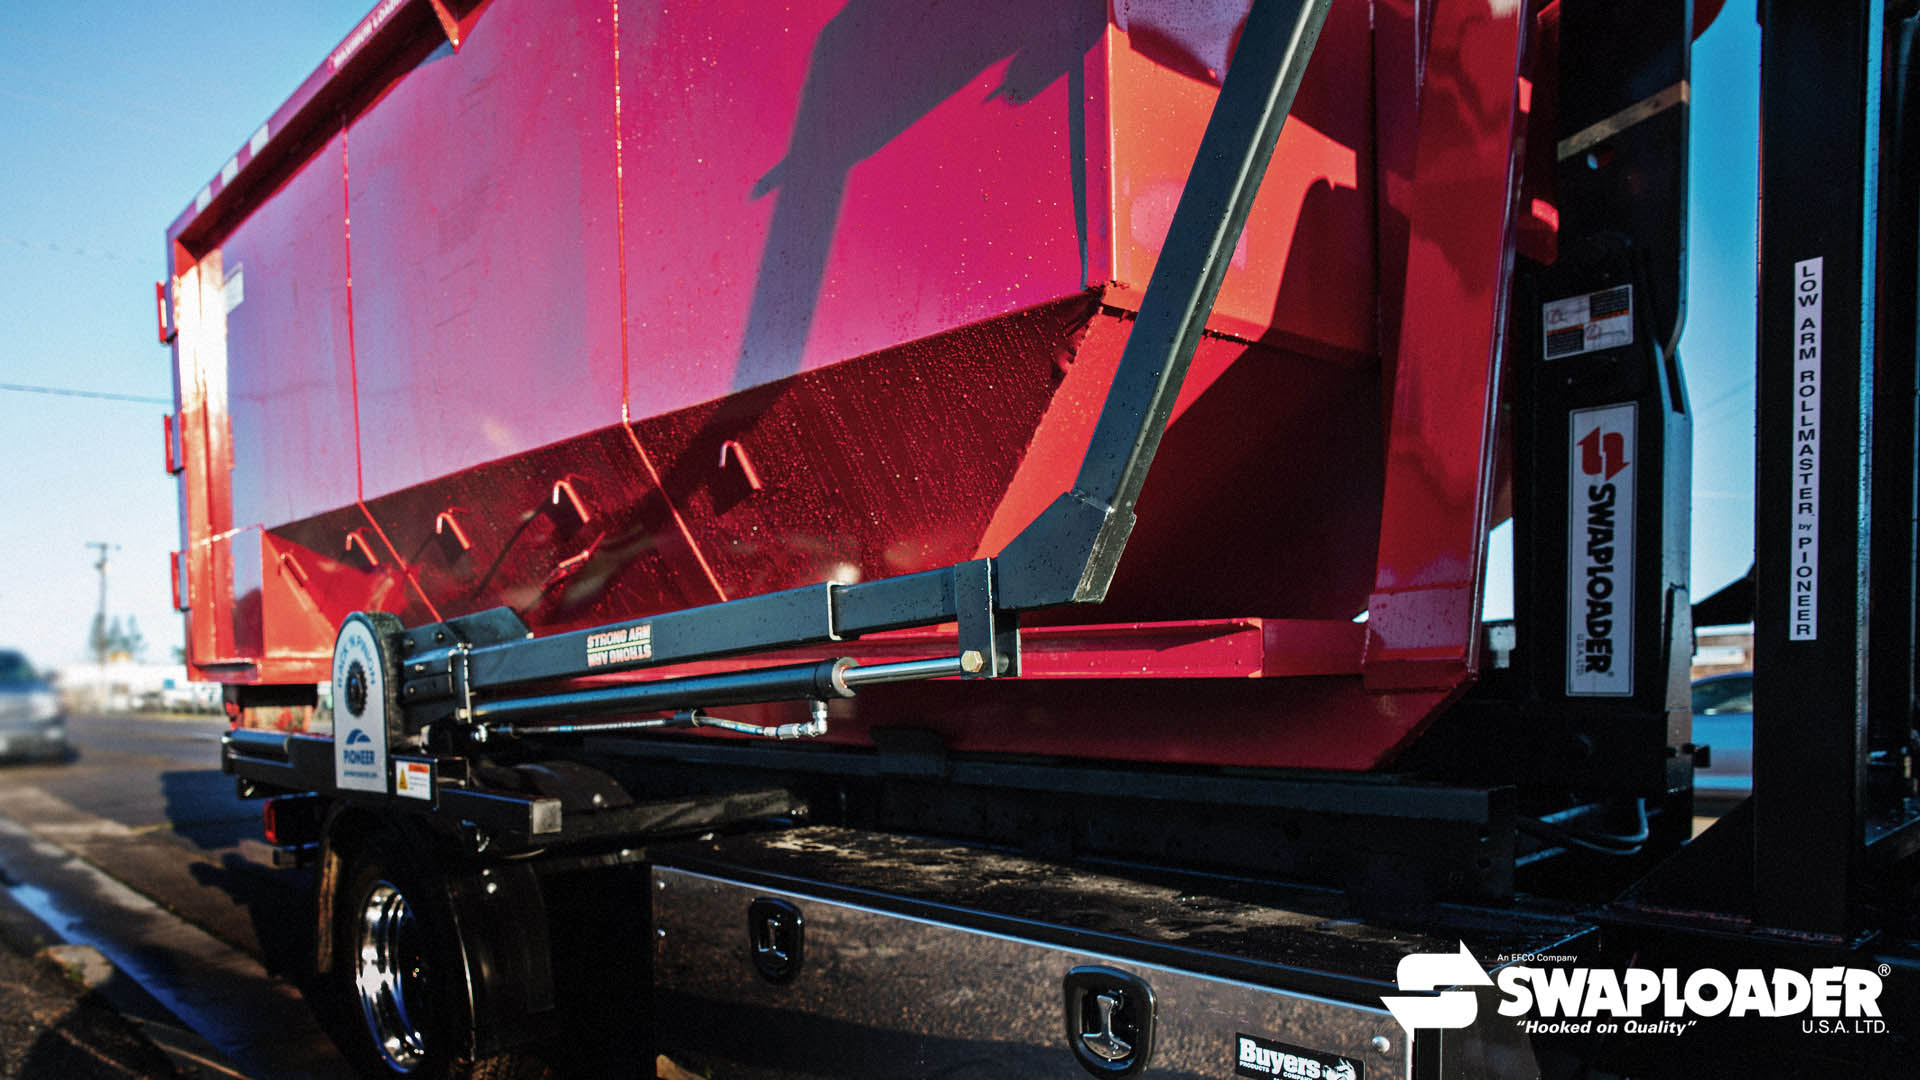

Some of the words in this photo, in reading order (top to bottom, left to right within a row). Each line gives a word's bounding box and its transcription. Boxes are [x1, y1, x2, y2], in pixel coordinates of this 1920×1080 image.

[1798, 265, 1818, 307] LOW
[1799, 317, 1816, 360] ARM
[1798, 370, 1816, 515] ROLLMASTER
[1799, 523, 1813, 531] by
[1585, 482, 1616, 673] SWAPLOADER
[1796, 537, 1813, 636] PIONEER
[587, 629, 627, 649] STRONG
[628, 624, 652, 641] ARM
[587, 651, 609, 667] ARM
[609, 644, 652, 664] STRONG
[343, 749, 375, 765] PIONEER
[1240, 1038, 1320, 1078] Buyers
[1240, 1061, 1270, 1073] PRODUCTS
